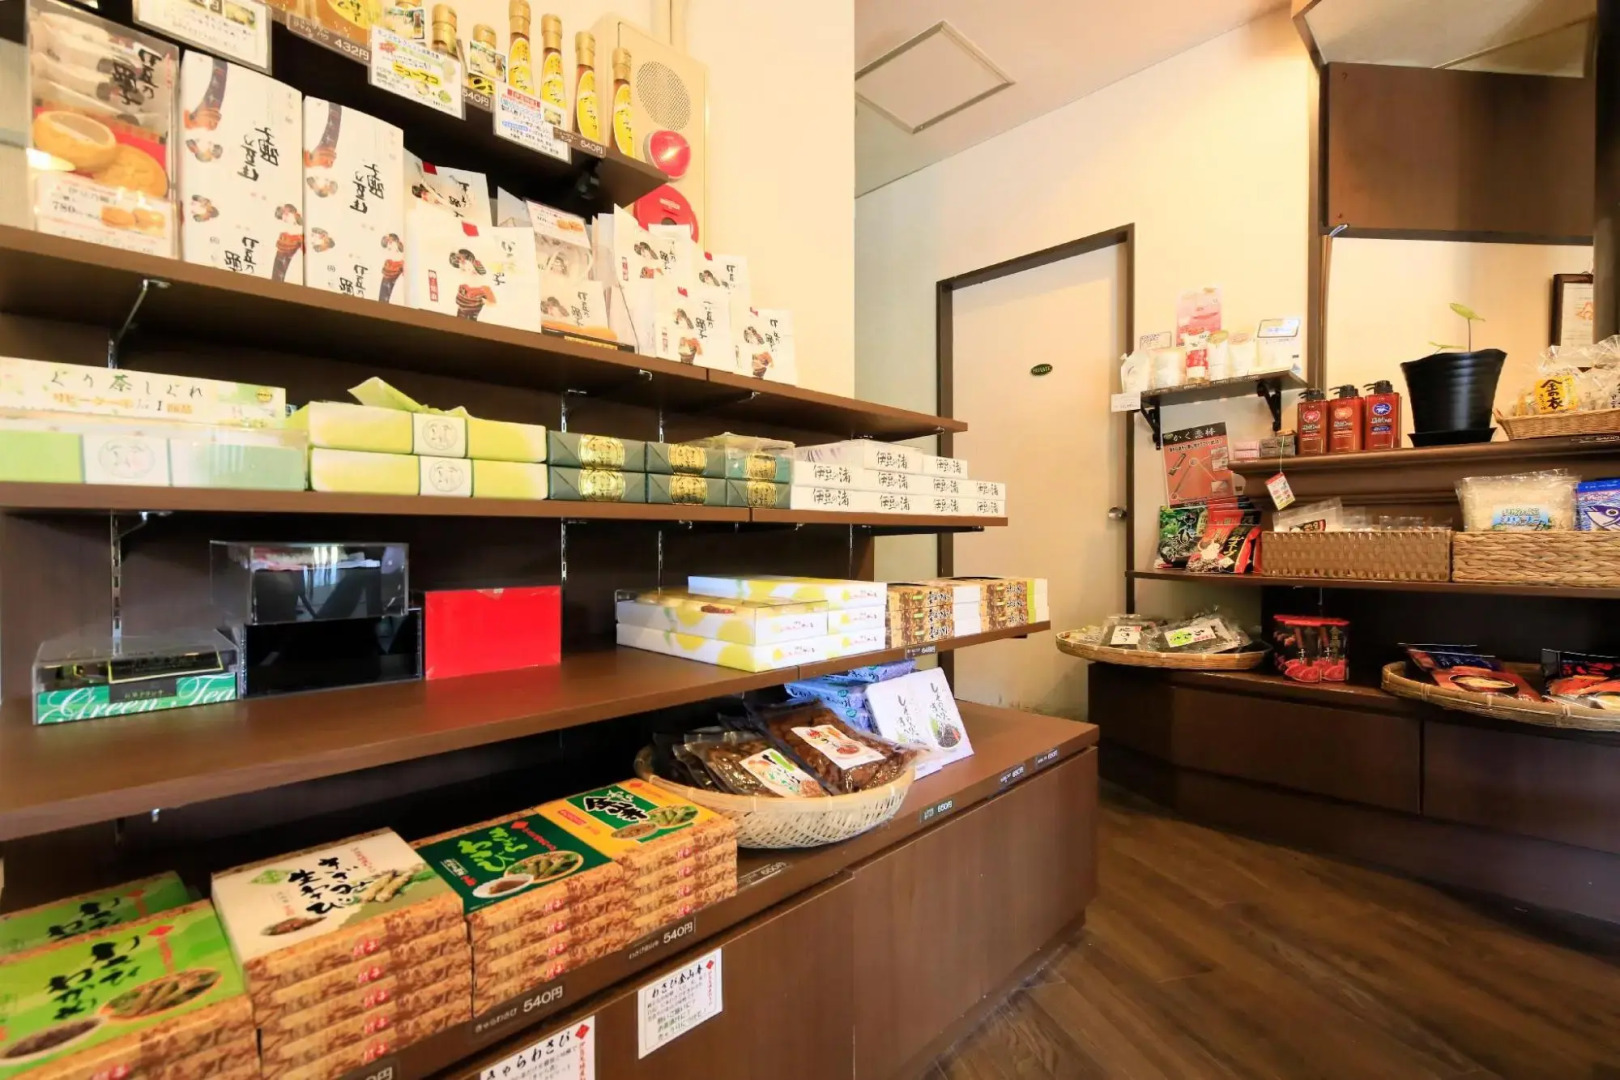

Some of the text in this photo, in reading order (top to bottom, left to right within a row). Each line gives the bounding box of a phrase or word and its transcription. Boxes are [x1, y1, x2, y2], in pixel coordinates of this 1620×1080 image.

[334, 38, 370, 61] 432円
[177, 673, 237, 706] Tea
[38, 686, 158, 724] Green
[663, 921, 694, 944] 540円
[522, 985, 564, 1014] 540円
